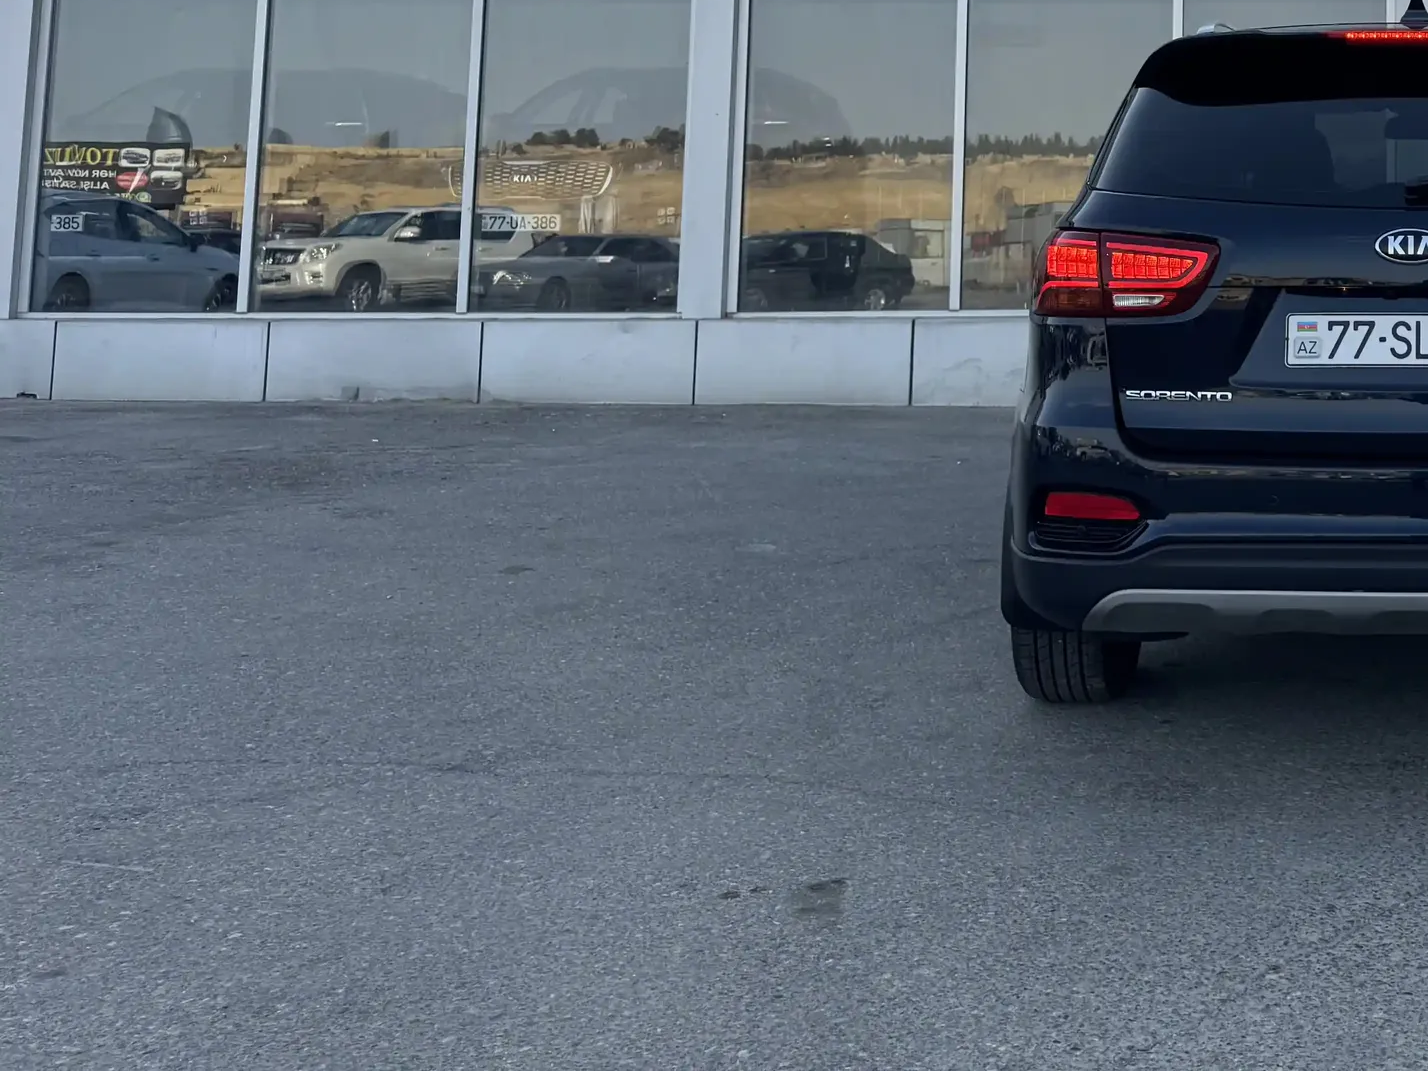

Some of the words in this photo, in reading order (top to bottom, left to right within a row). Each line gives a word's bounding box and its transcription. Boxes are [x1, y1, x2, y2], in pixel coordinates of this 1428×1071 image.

[513, 174, 532, 183] KIA
[489, 215, 558, 229] 77-UA-386
[1297, 341, 1318, 355] AZ
[1125, 390, 1233, 402] SORENTO
